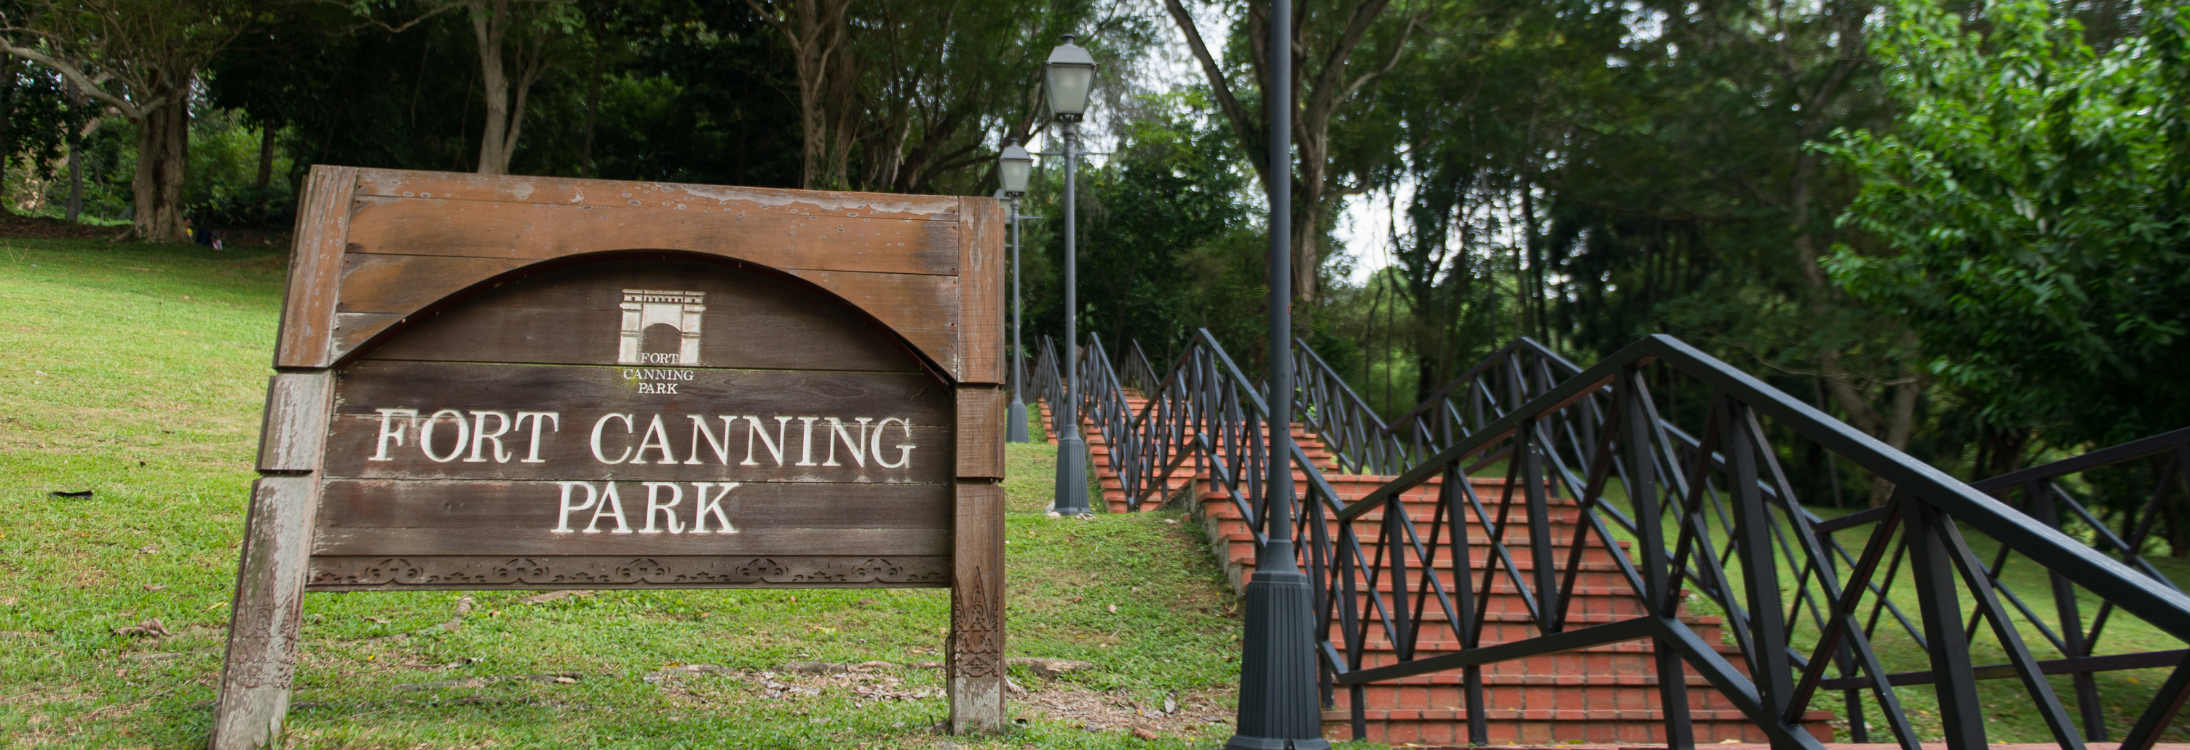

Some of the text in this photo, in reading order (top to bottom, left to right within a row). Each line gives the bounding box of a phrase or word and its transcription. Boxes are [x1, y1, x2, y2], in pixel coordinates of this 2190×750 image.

[641, 353, 678, 363] FORT
[623, 369, 694, 380] CANNING
[638, 383, 678, 394] PARK
[368, 408, 917, 469] FORT CANNING
[551, 481, 740, 534] PARK
